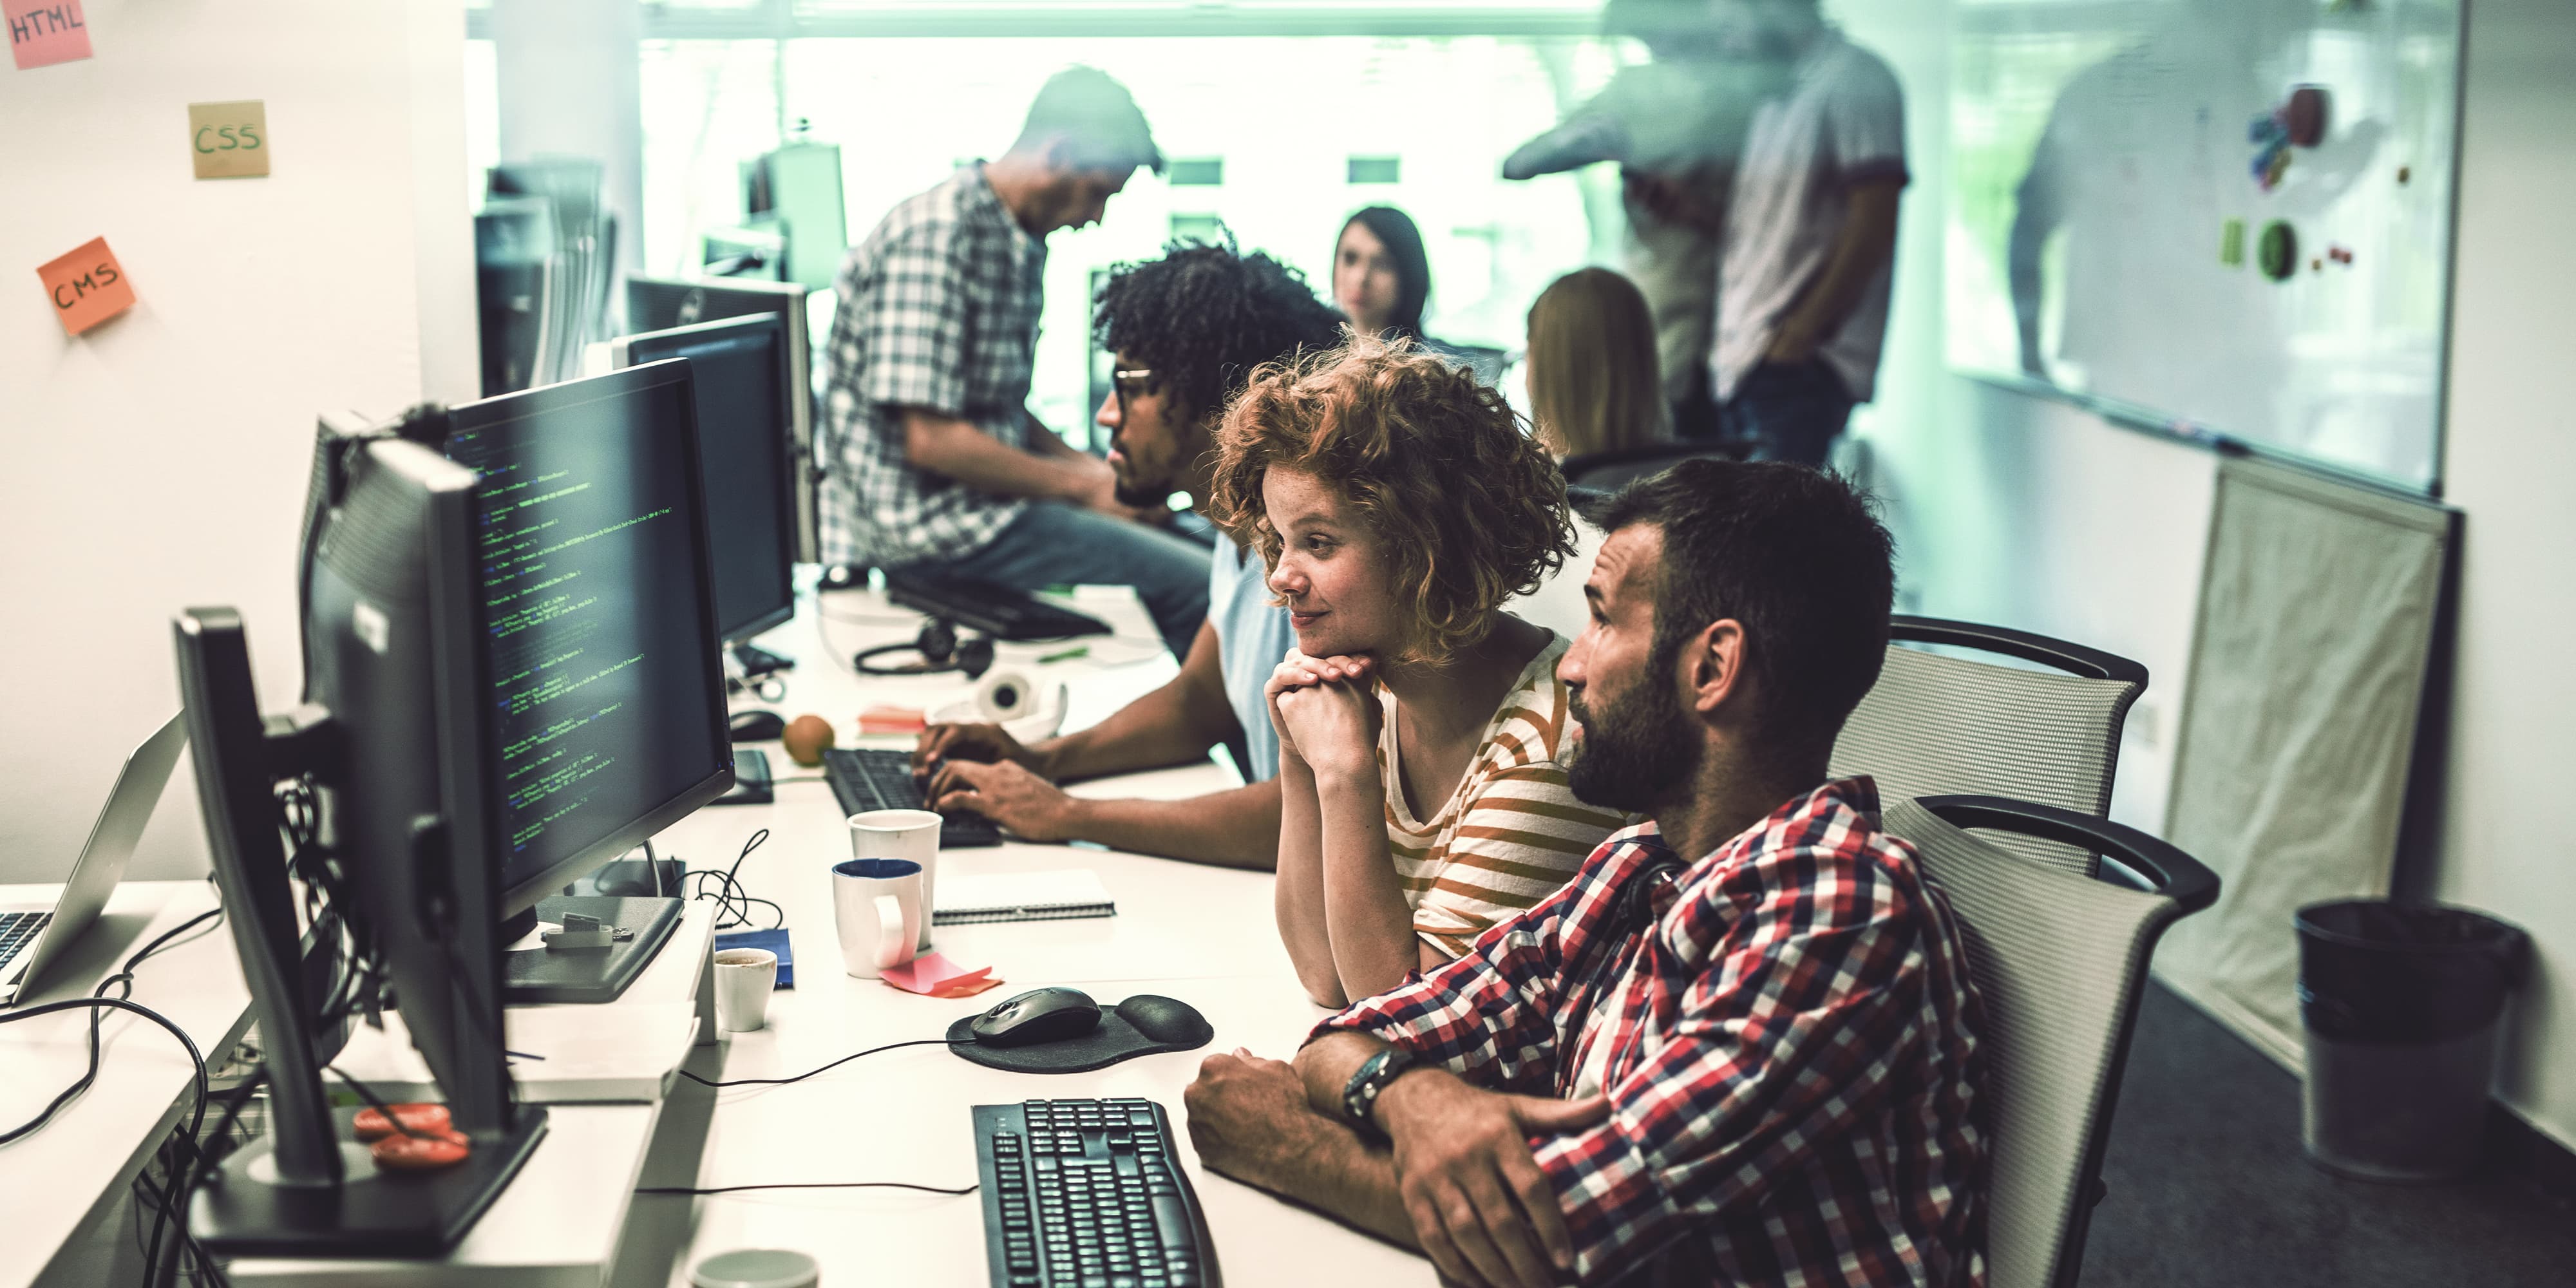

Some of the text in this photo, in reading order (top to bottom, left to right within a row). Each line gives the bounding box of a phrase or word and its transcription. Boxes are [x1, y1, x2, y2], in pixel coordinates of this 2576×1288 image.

[10, 5, 83, 44] HTML
[195, 124, 260, 154] CSS
[55, 263, 118, 309] CMS
